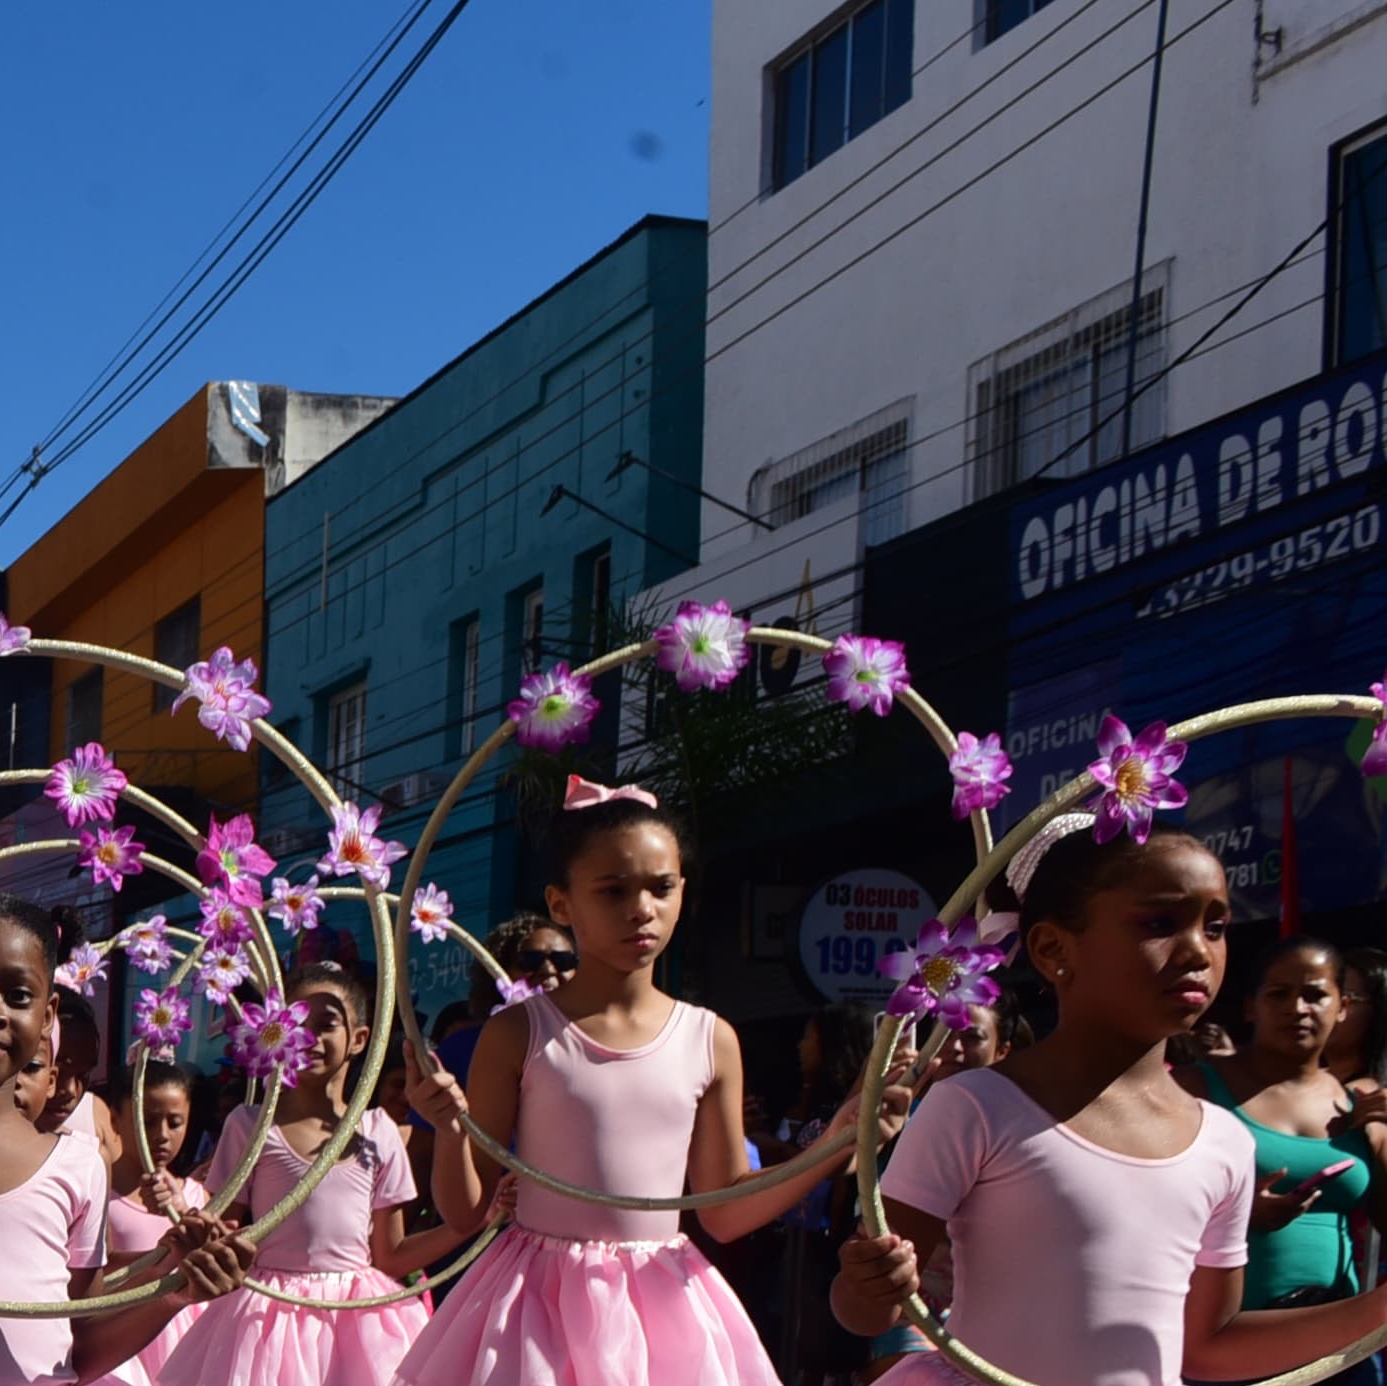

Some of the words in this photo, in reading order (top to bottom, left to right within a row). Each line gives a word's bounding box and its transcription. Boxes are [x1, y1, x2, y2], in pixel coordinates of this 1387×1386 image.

[1019, 453, 1201, 599] OFICINA
[1218, 416, 1283, 526] DE
[1297, 372, 1387, 496] RO
[826, 884, 851, 906] 03
[854, 884, 920, 909] ÓCULOS
[843, 911, 898, 932] SOLAR
